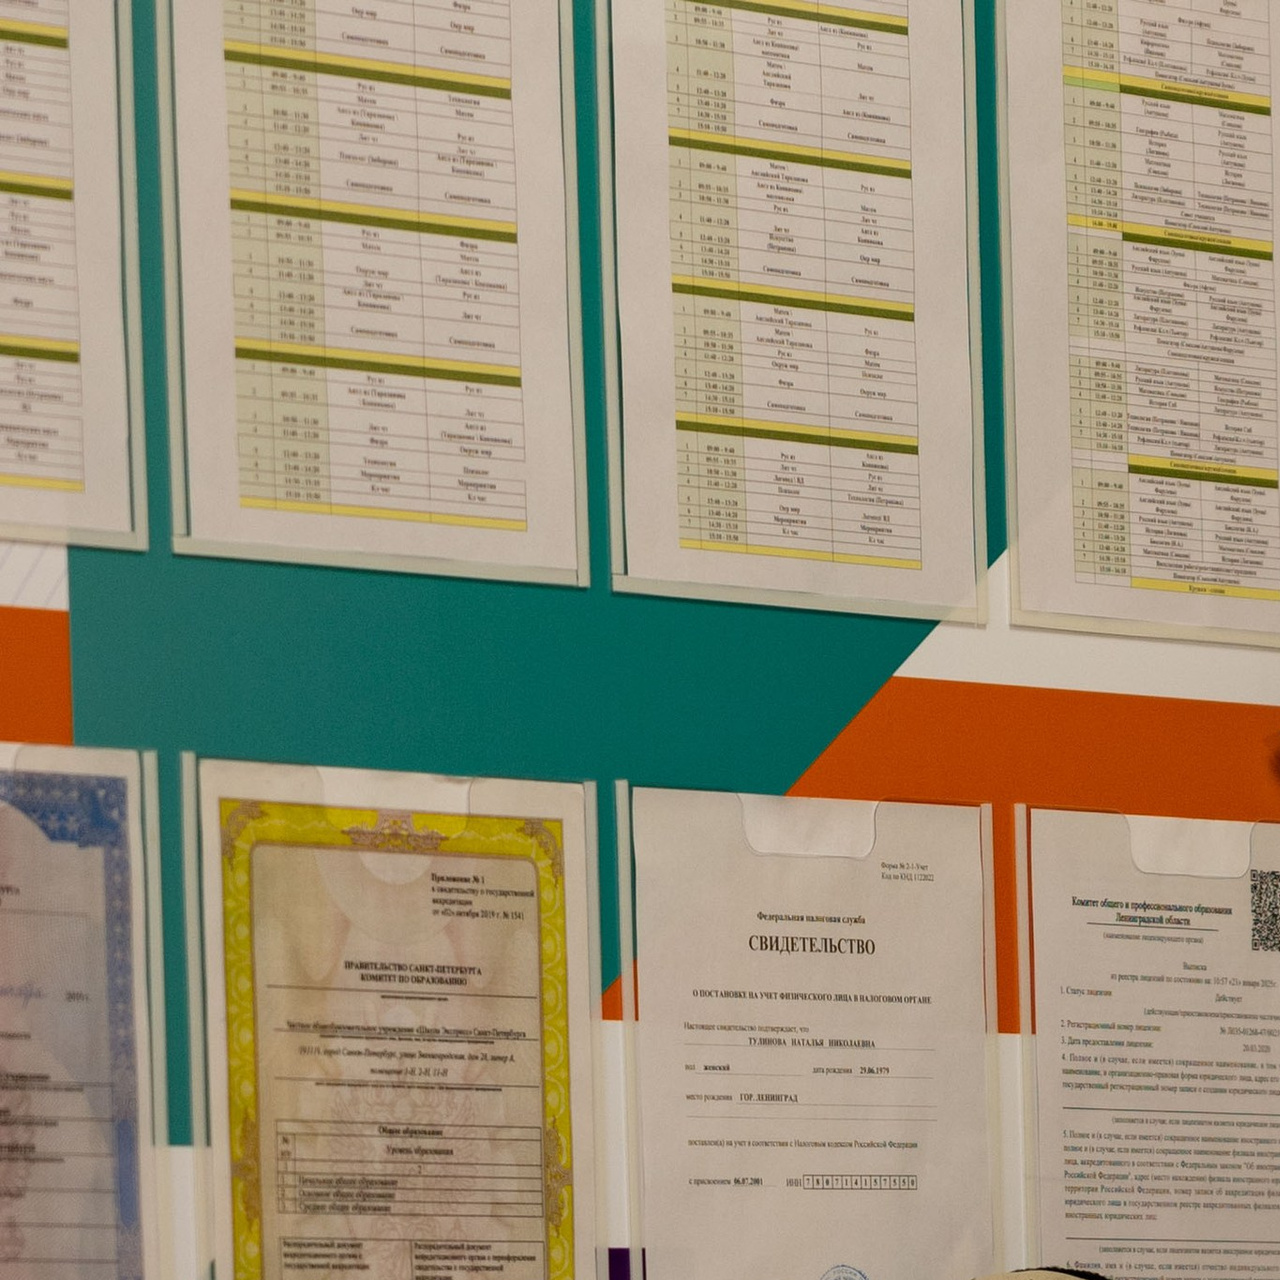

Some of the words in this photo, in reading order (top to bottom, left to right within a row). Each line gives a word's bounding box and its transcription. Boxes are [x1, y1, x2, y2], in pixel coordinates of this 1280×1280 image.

[430, 874, 471, 884] Приложение
[881, 872, 892, 880] Код
[1071, 898, 1098, 907] Комитет
[1099, 900, 1124, 908] общего
[1124, 901, 1129, 909] и
[1130, 901, 1193, 912] профессионального
[1193, 905, 1232, 915] образования
[756, 913, 804, 922] Федеральная
[805, 915, 841, 923] налоговая
[841, 916, 865, 924] служба
[1115, 914, 1164, 924] Ленинградской
[1164, 917, 1190, 926] области
[749, 934, 875, 955] СВИДЕТЕЛЬСТВО
[343, 960, 408, 972] ПРАВИТЕЛЬСТВО
[408, 963, 481, 975] САНКТ-ПЕТЕРБУРГА
[359, 972, 396, 983] КОМИТЕТ
[397, 974, 410, 983] ПО
[410, 975, 470, 986] ОБРАЗОВАНИЮ
[1117, 973, 1139, 981] реестра
[1139, 974, 1165, 982] лицензий
[1173, 976, 1203, 984] состоянию
[692, 989, 698, 997] О
[699, 989, 747, 998] ПОСТАНОВКЕ
[748, 991, 758, 999] НА
[759, 991, 777, 999] УЧЕТ
[779, 991, 832, 1001] ФИЗИЧЕСКОГО
[833, 993, 852, 1002] ЛИЦА
[853, 994, 858, 1002] В
[859, 994, 902, 1003] НАЛОГОВОМ
[903, 995, 931, 1004] ОРГАНЕ
[1065, 987, 1085, 995] Статус
[1086, 988, 1112, 996] лицензии
[1214, 994, 1242, 1003] Действует
[757, 1025, 798, 1033] подтверждает,
[1066, 1021, 1116, 1030] Регистрационный
[748, 1037, 786, 1047] ТУЛИНОВА
[791, 1038, 824, 1047] НАТАЛЬЯ
[828, 1038, 875, 1049] НИКОЛАЕВНА
[1067, 1037, 1081, 1045] Дата
[1081, 1038, 1125, 1047] предоставления
[859, 1066, 889, 1074] 29.06.1979
[756, 1093, 798, 1102] ЛЕНИНГРАД
[377, 1125, 401, 1138] Общее
[400, 1127, 444, 1139] образование
[853, 1140, 887, 1148] Российской
[385, 1146, 413, 1155] Уровень
[412, 1147, 454, 1156] образования
[733, 1177, 763, 1186] 06.07.2001
